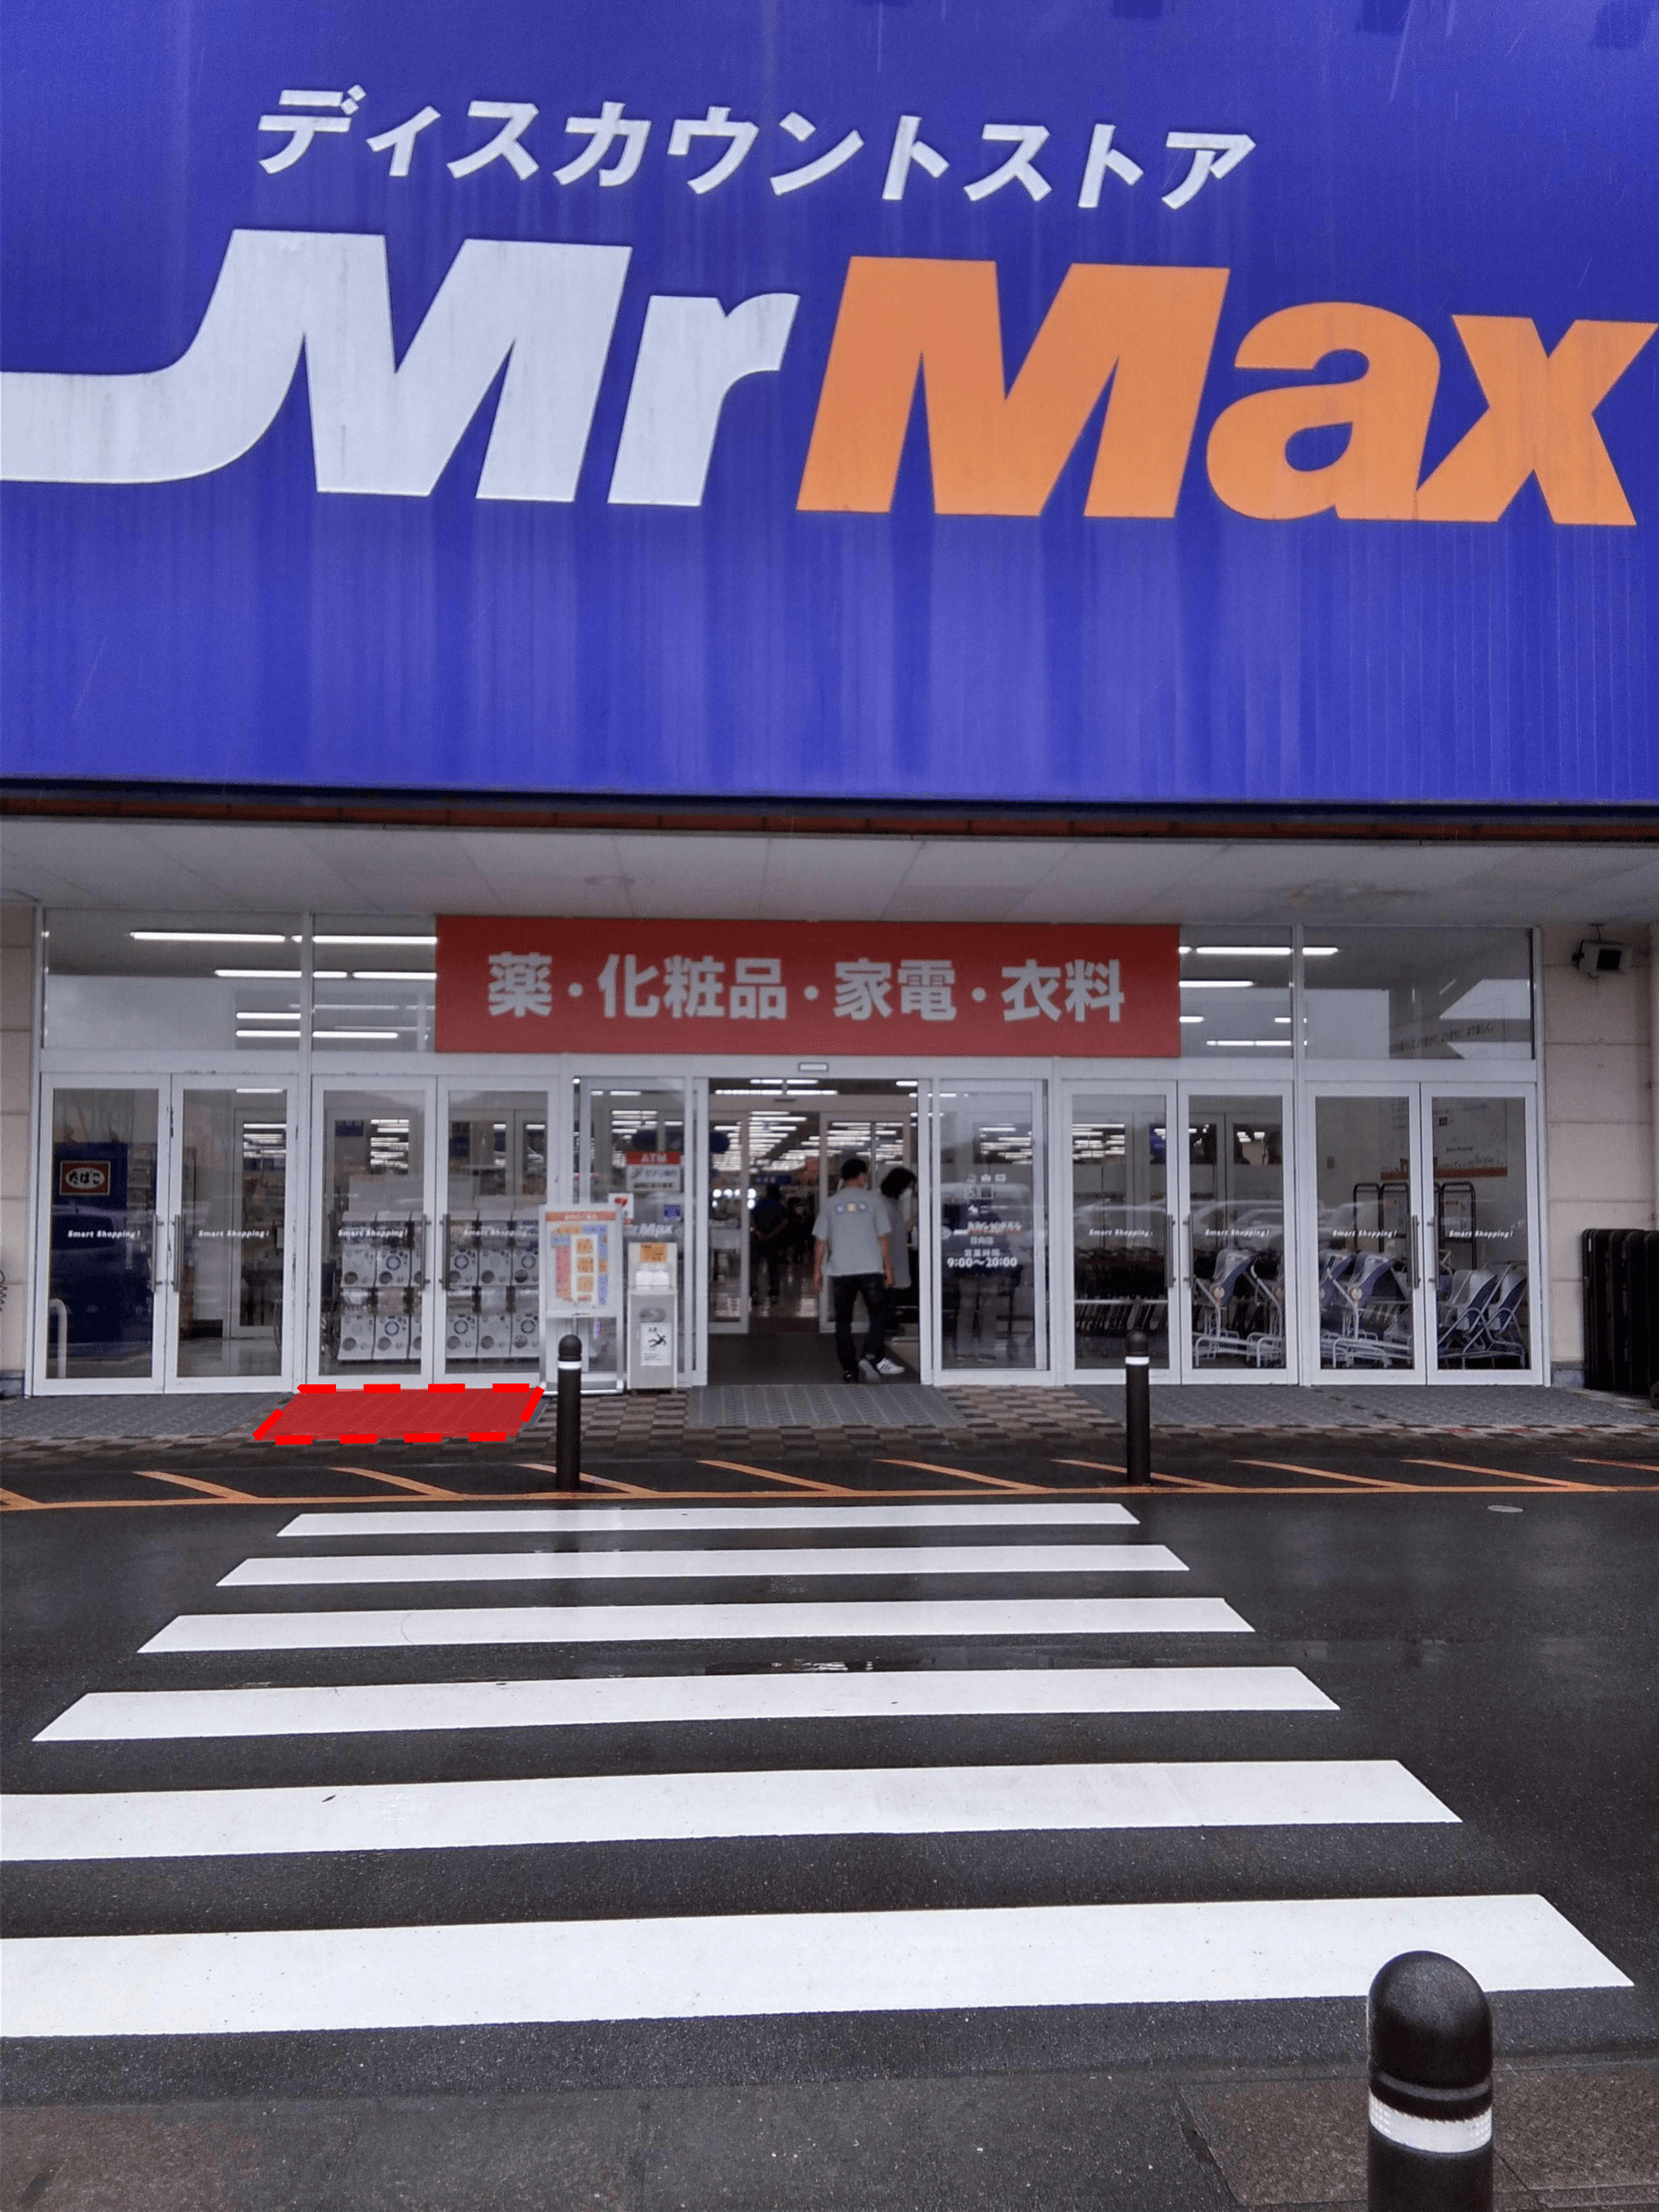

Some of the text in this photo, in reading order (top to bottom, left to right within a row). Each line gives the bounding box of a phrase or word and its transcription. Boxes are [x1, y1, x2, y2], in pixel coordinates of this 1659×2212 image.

[258, 84, 1255, 210] ディスカウントストア
[0, 227, 1659, 526] MrMax
[488, 951, 1124, 1024] 薬・化粧品・家電・衣料
[641, 1152, 667, 1164] ATM
[69, 1171, 101, 1185] たばこ
[68, 1230, 94, 1238] Smart
[198, 1230, 223, 1238] Smart
[1332, 1230, 1356, 1238] Smart
[1449, 1230, 1472, 1238] Smart
